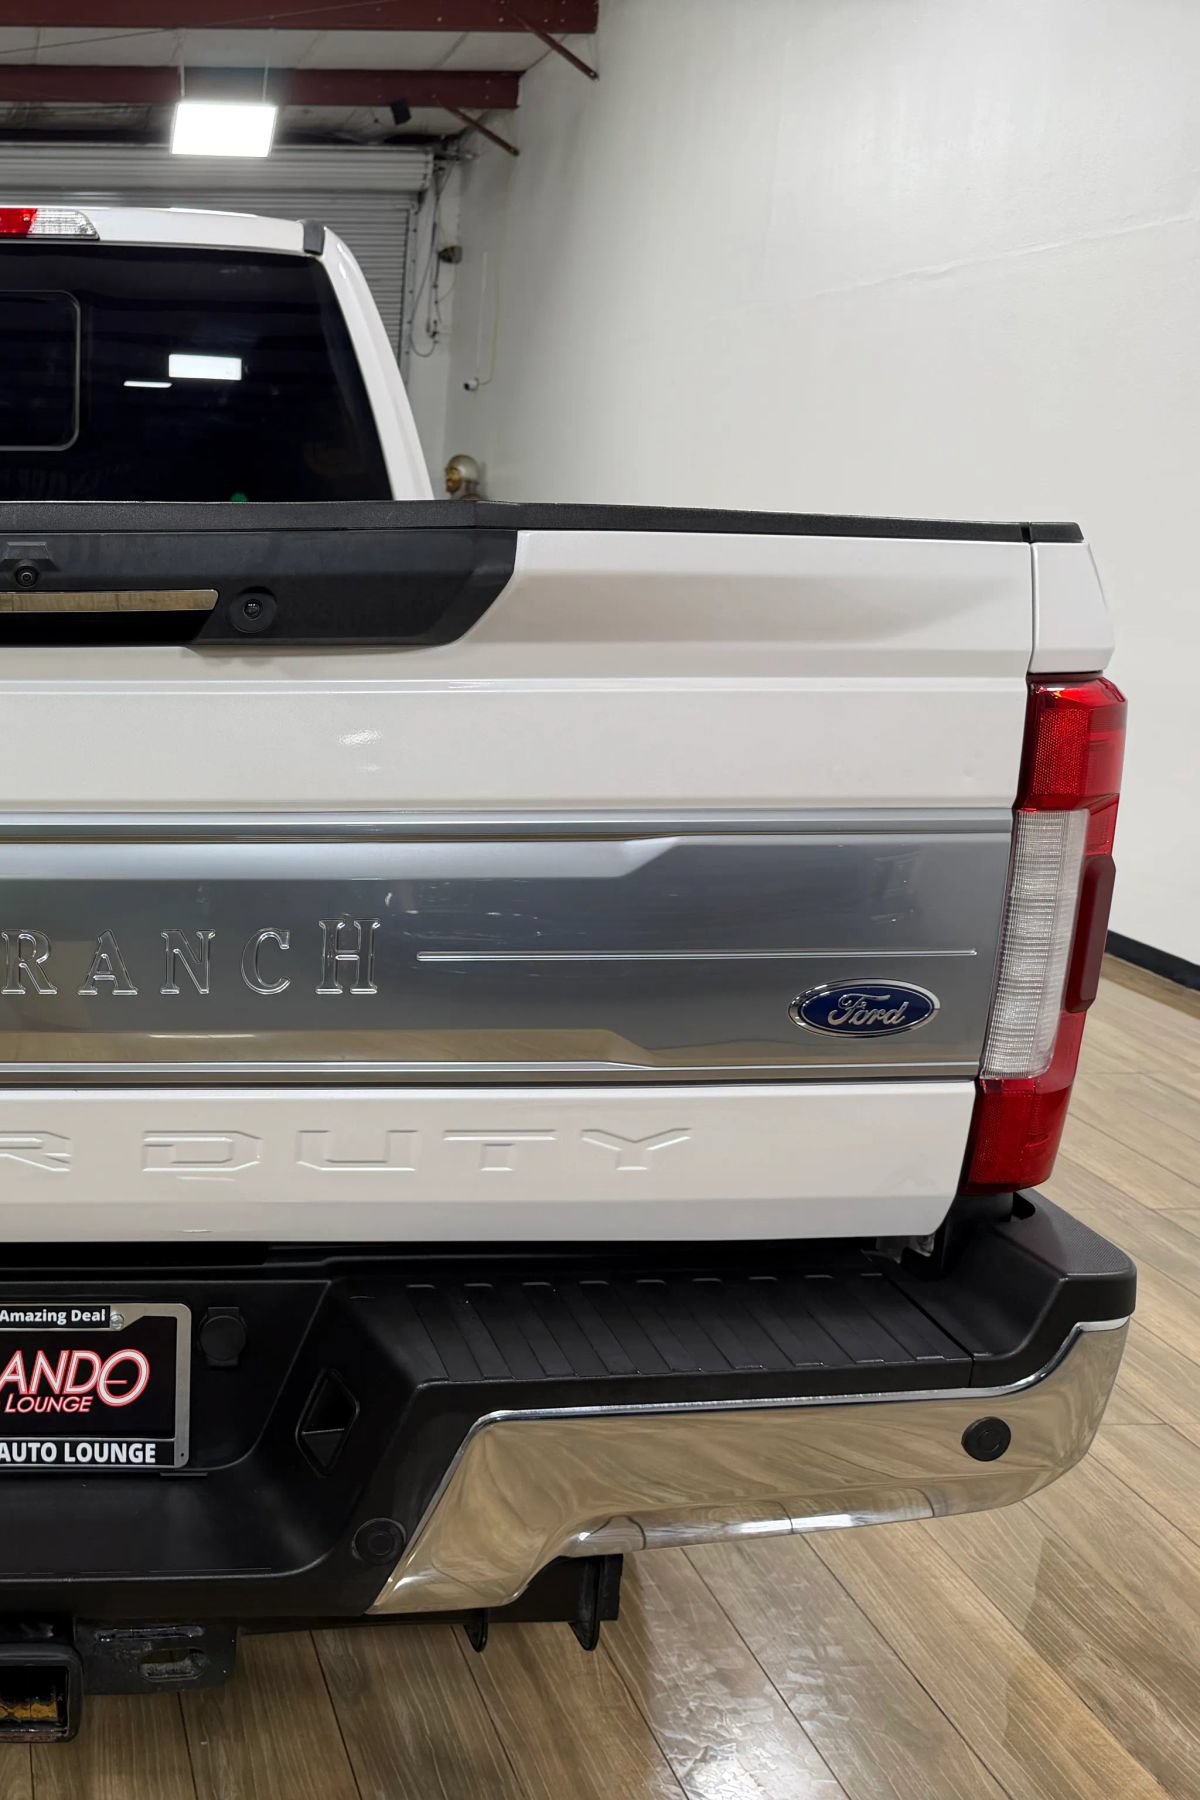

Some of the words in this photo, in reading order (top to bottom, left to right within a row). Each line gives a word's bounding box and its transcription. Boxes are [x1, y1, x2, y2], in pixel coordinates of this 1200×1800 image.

[1, 914, 381, 996] RANCH
[827, 993, 909, 1026] Ford
[140, 1126, 693, 1174] DUTY
[71, 1309, 106, 1323] Deal
[4, 1392, 94, 1414] LOUNGE
[63, 1442, 157, 1464] LOUNGE
